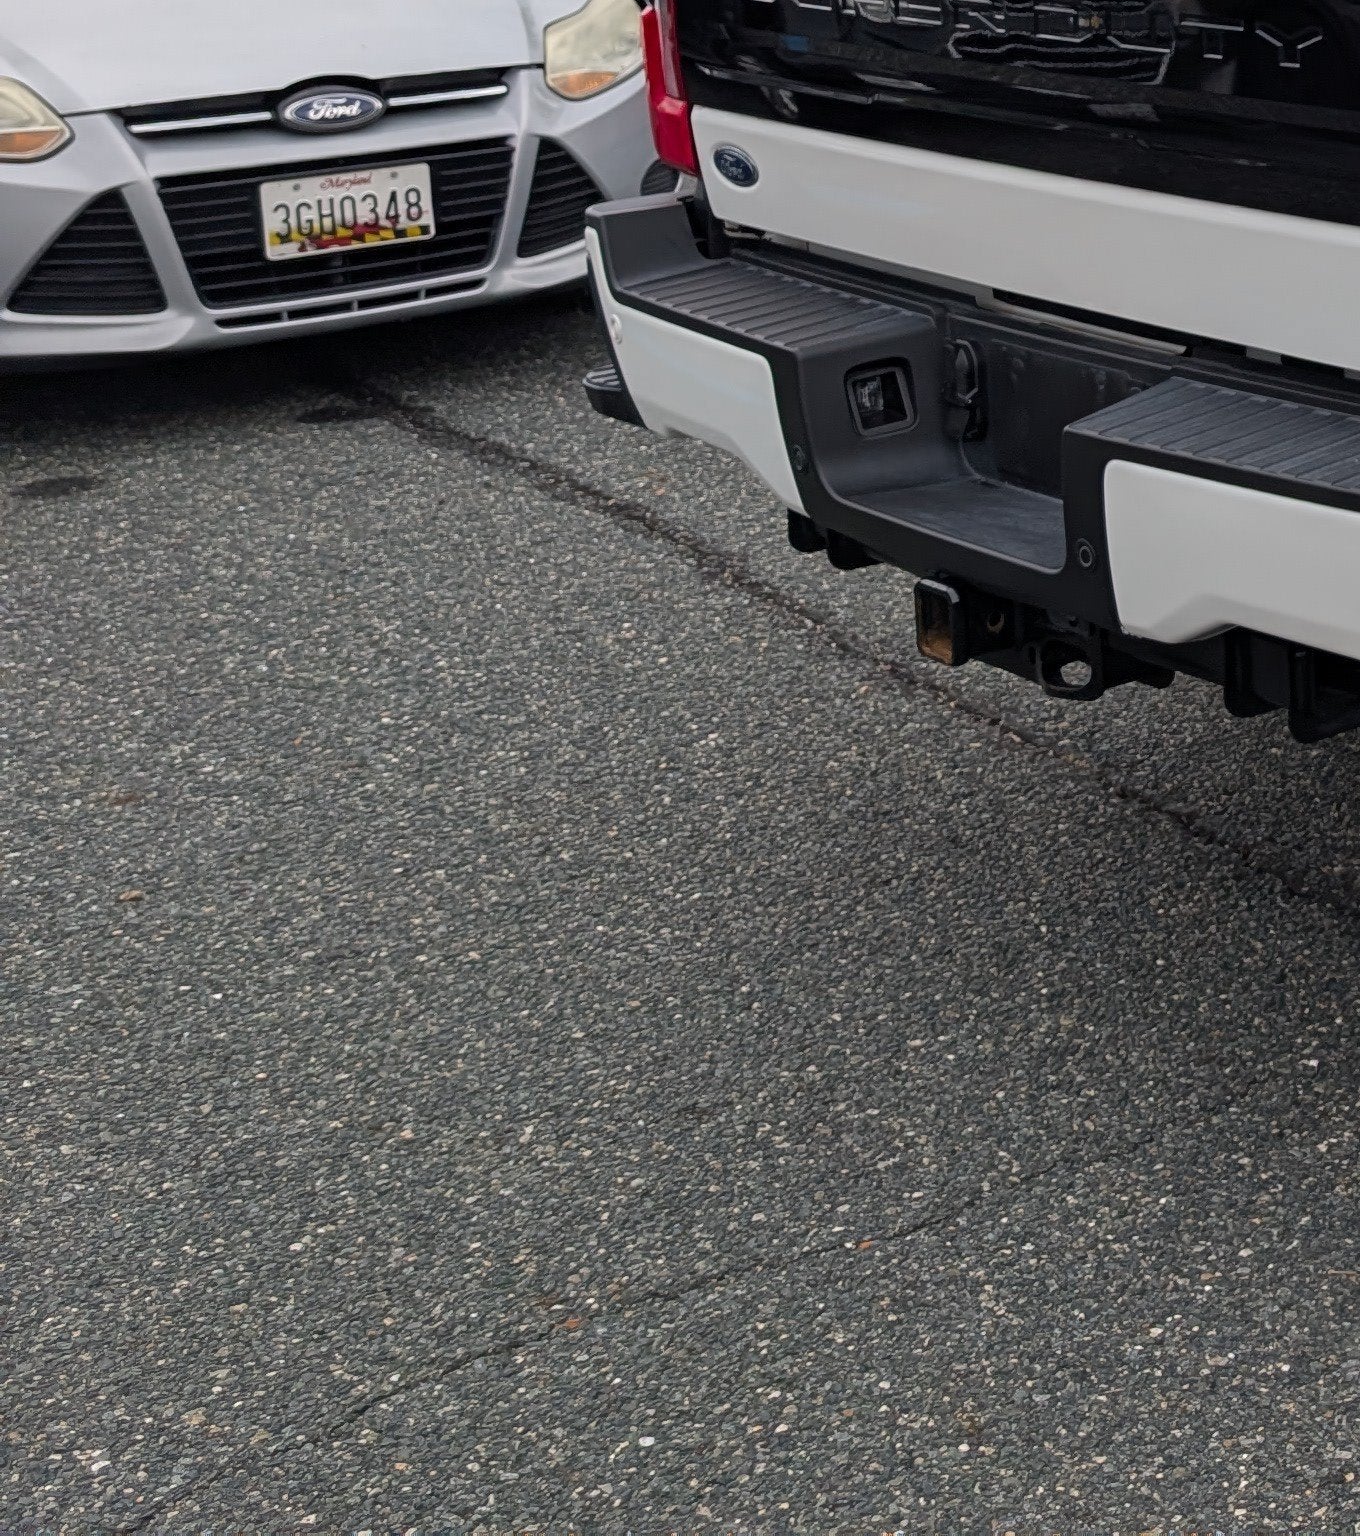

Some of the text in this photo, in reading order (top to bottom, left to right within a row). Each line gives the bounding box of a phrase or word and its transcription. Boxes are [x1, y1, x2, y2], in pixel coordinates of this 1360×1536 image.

[1034, 2, 1324, 68] DUTY
[308, 97, 363, 120] Ford
[319, 173, 373, 191] Maryland
[272, 187, 423, 241] 3GH0348
